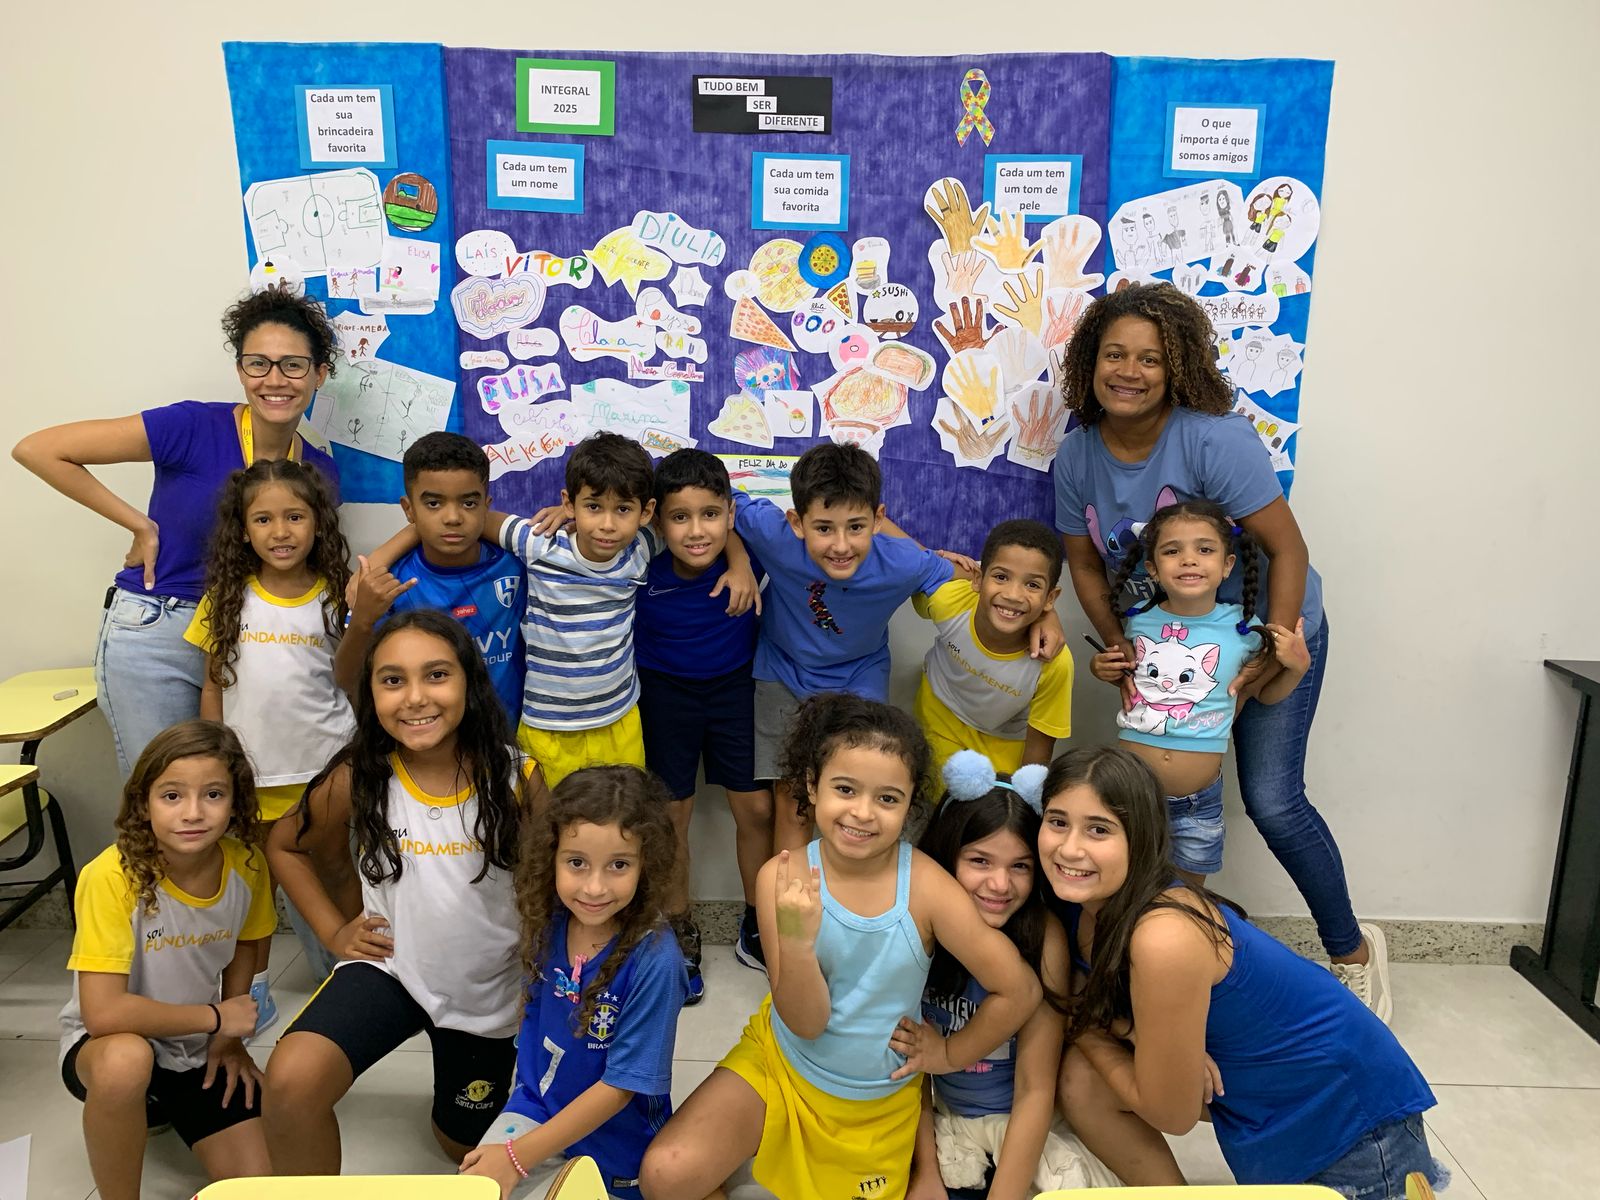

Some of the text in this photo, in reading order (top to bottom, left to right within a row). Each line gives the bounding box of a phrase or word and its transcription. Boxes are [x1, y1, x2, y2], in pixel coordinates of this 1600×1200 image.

[541, 85, 591, 96] INTEGRAL
[703, 81, 759, 92] TUDO BEM
[310, 93, 376, 104] Cada um tem
[553, 103, 578, 114] 2025
[752, 100, 772, 110] SER
[335, 111, 353, 120] sua
[764, 115, 819, 127] DIFERENTE
[1201, 118, 1232, 131] O que
[317, 126, 374, 137] brincadeira
[1180, 133, 1250, 147] importa é que
[327, 143, 367, 154] favorita
[1178, 152, 1249, 164] somos amigos
[502, 161, 568, 174] Cada um tem
[999, 167, 1065, 178] Cada um tem
[769, 168, 835, 181] Cada um tem
[511, 179, 558, 190] um nome
[1004, 185, 1058, 195] um tom de
[773, 185, 829, 197] sua comida
[782, 201, 820, 212] favorita
[1019, 201, 1041, 212] pele
[407, 246, 432, 260] ELISA
[738, 459, 762, 470] FELIZ
[239, 631, 325, 648] UNDAMENTAL
[587, 1042, 612, 1050] BRAS
[538, 1035, 566, 1098] 7
[455, 1097, 475, 1110] Santa
